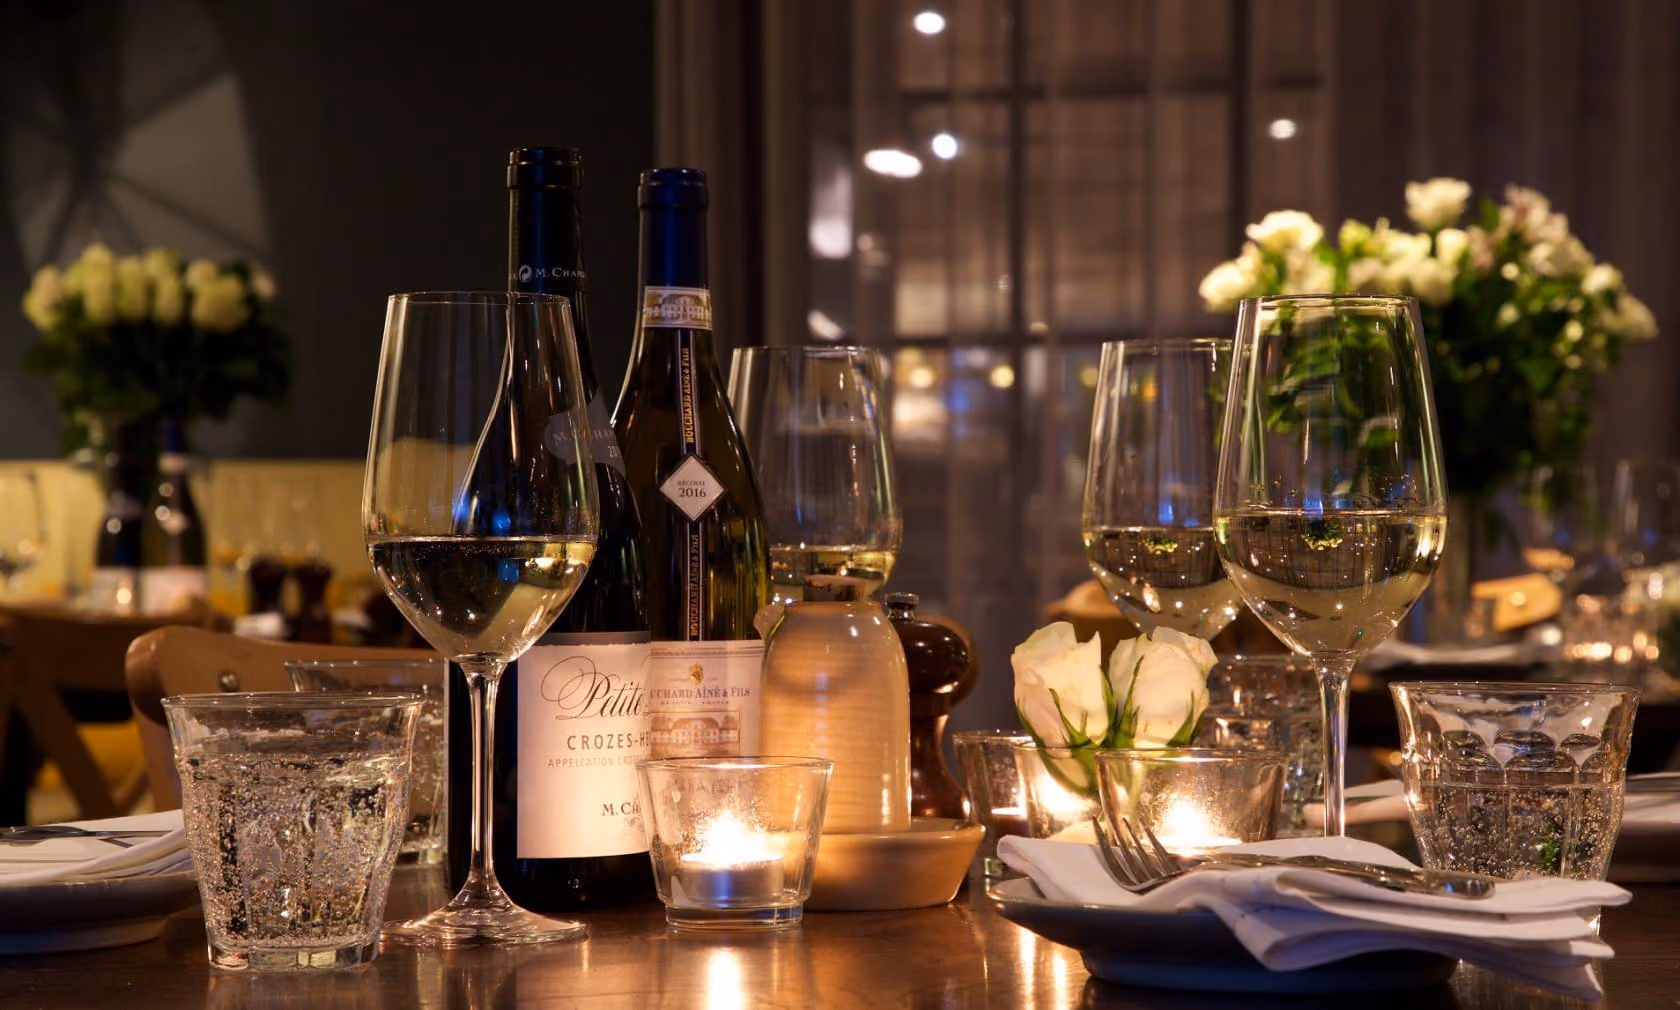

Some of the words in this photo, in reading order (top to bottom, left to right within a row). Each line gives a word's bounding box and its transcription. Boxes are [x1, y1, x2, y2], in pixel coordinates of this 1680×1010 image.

[678, 487, 707, 498] 2016
[721, 688, 729, 699] &
[601, 803, 619, 816] M.
